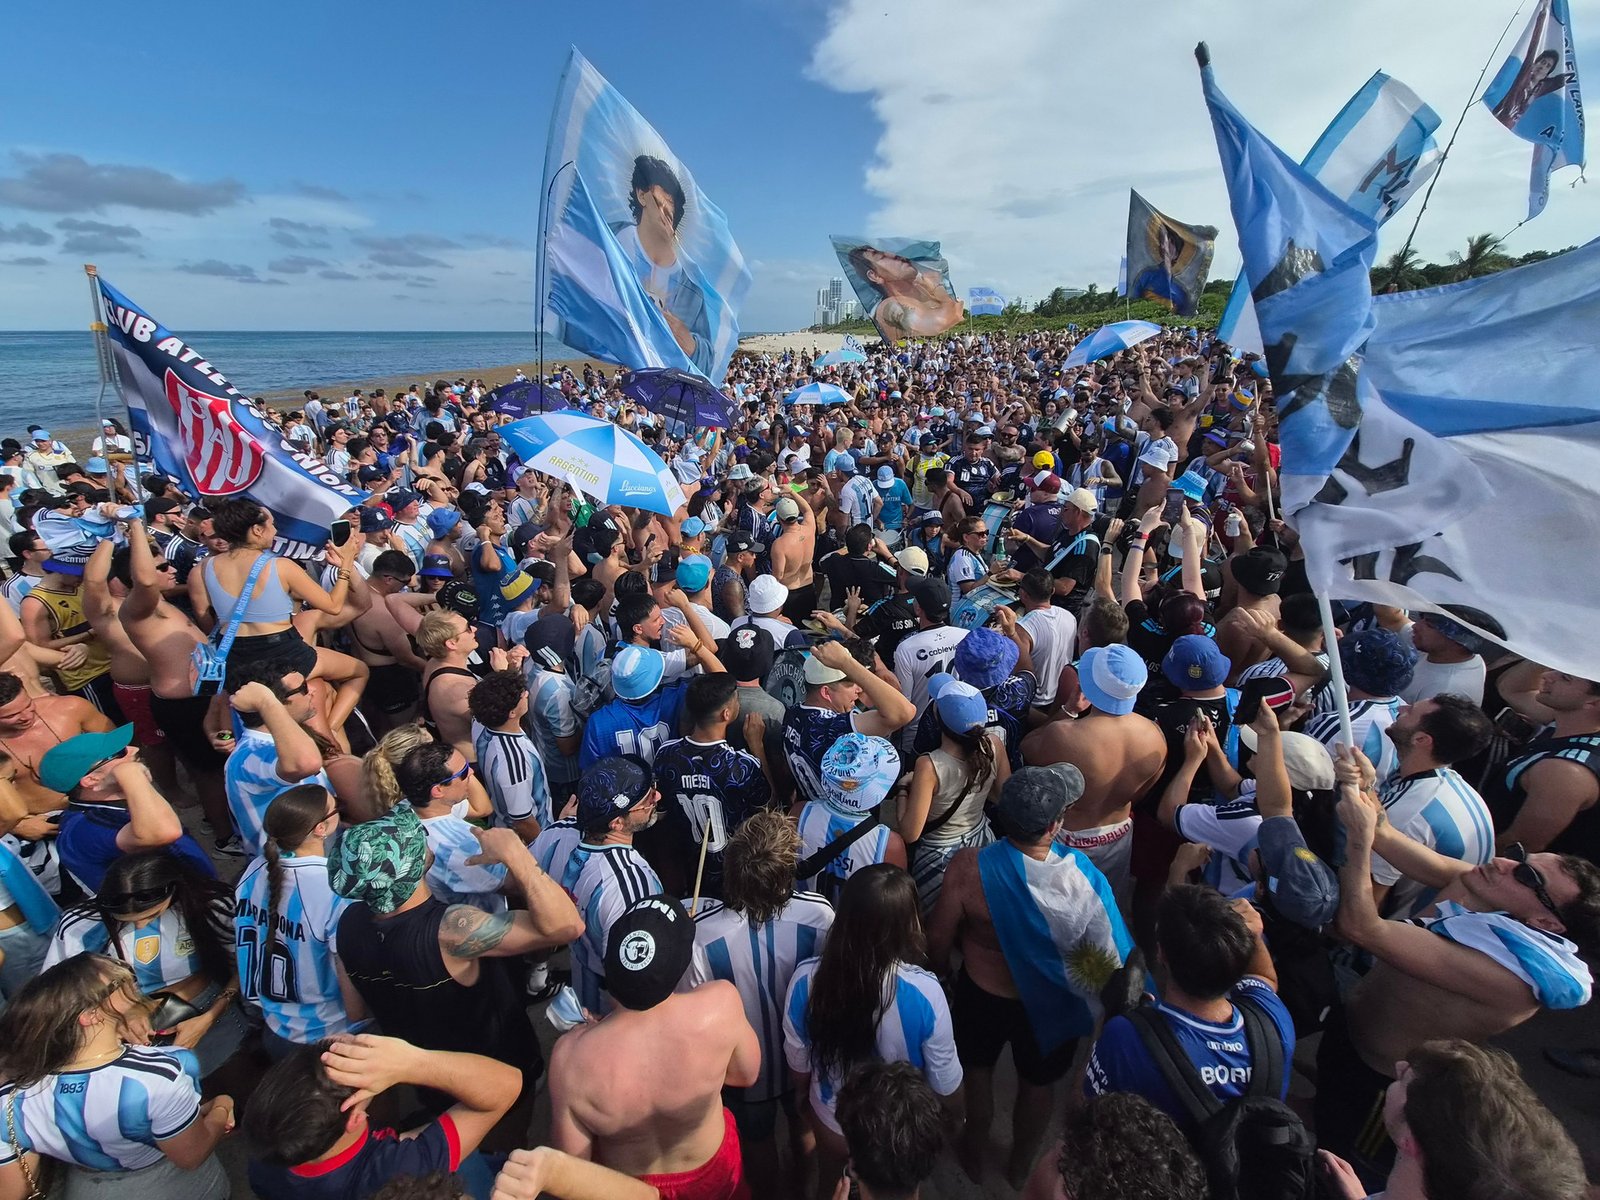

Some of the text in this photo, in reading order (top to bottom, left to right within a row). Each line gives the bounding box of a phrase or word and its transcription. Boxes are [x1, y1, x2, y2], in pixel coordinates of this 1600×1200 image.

[548, 455, 600, 486] ARGENTINA
[961, 472, 970, 481] 10
[235, 582, 255, 616] ARGENTINA
[220, 619, 240, 652] ARGENTINA
[615, 721, 671, 765] 10
[681, 774, 711, 790] MESSI
[675, 793, 729, 854] 10
[626, 899, 678, 923] SMO
[238, 926, 300, 1003] 10
[1207, 1040, 1243, 1052] umbro
[59, 1081, 86, 1095] 1893
